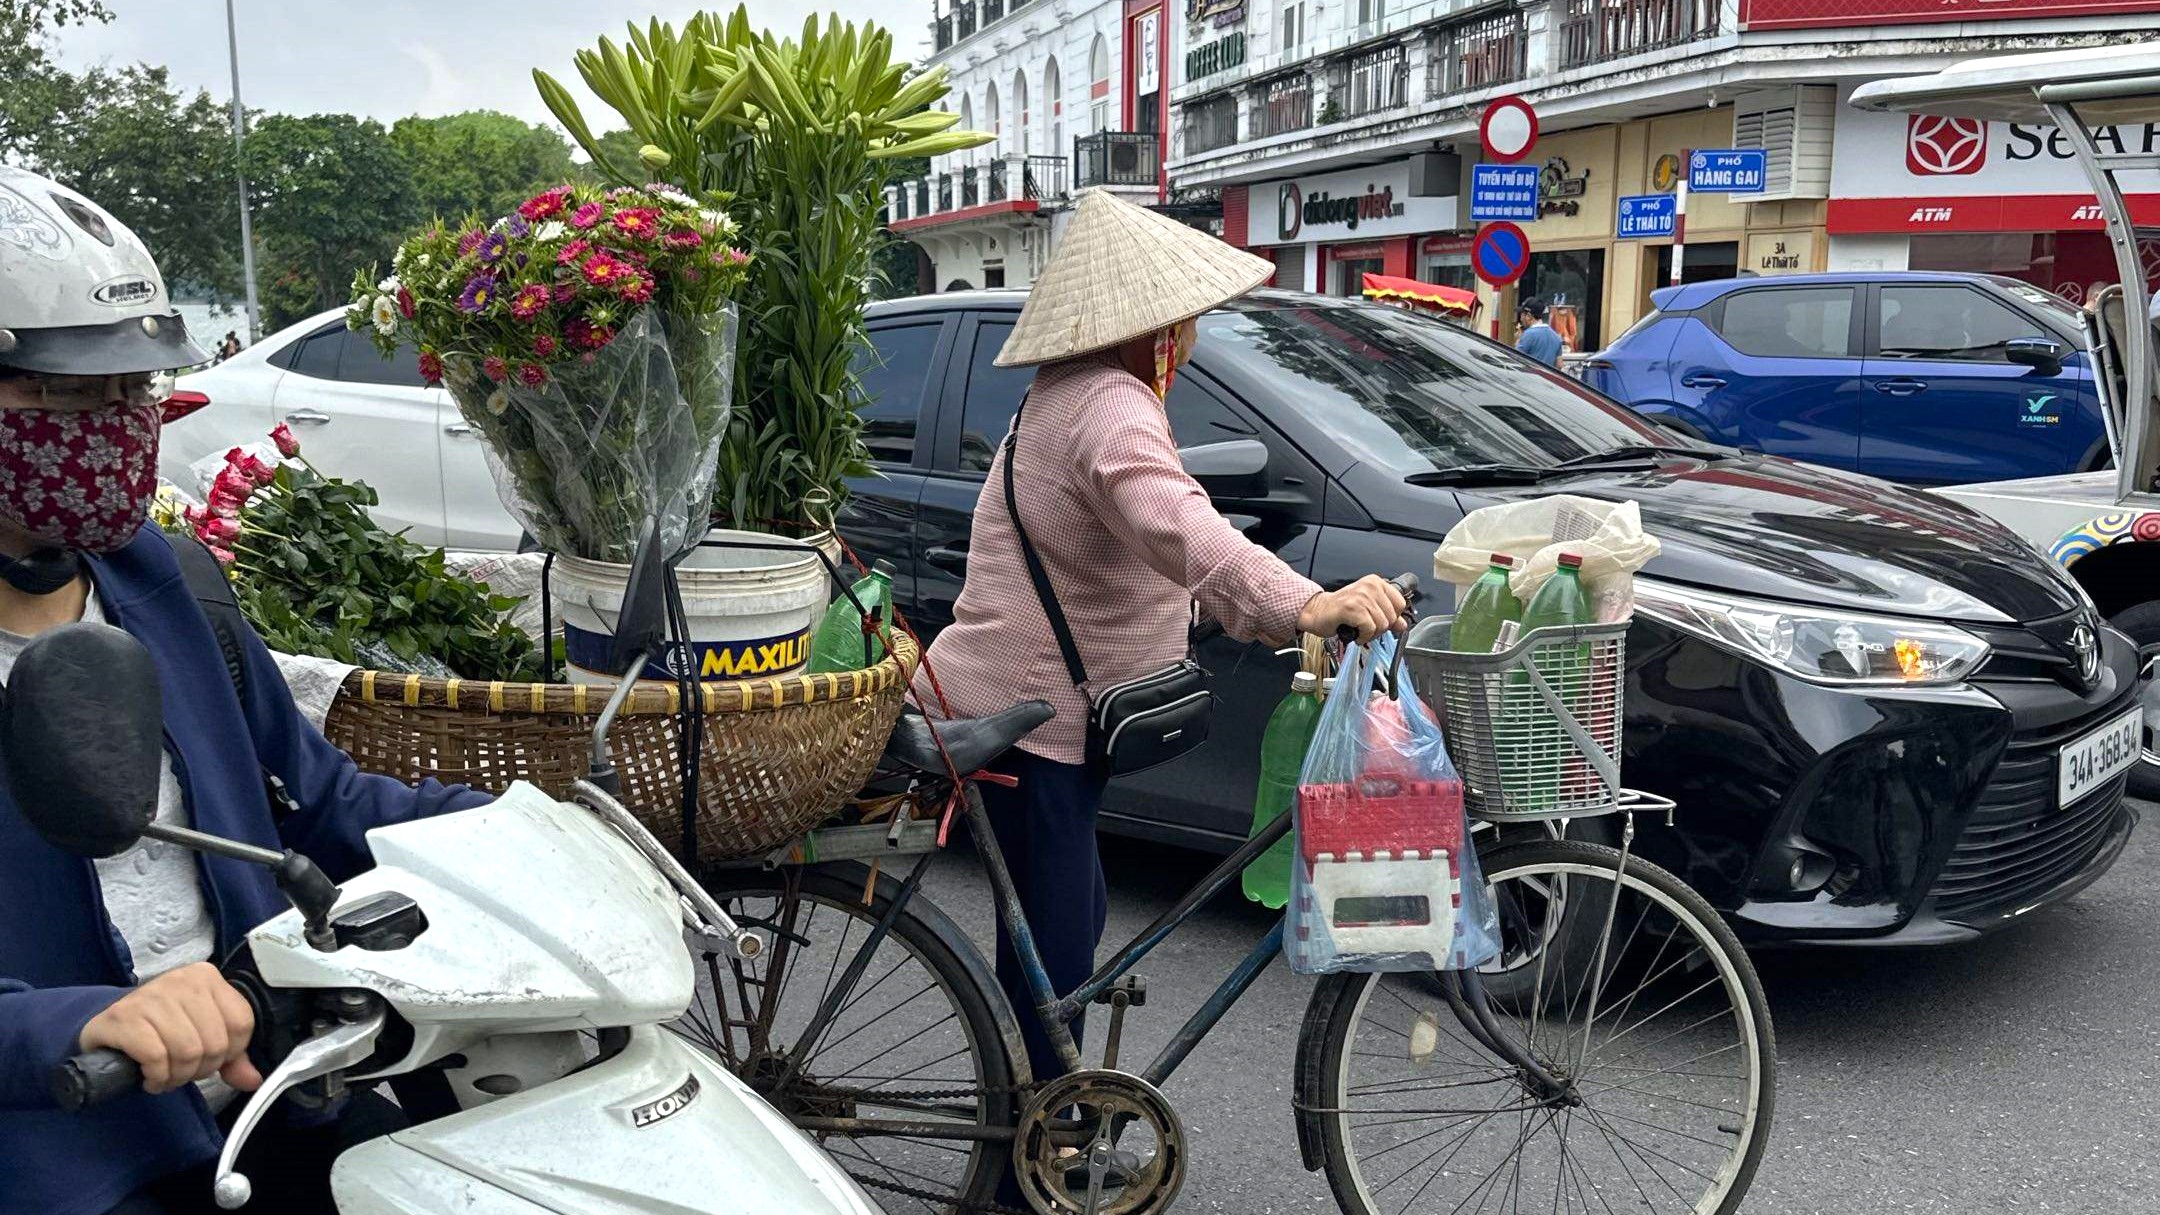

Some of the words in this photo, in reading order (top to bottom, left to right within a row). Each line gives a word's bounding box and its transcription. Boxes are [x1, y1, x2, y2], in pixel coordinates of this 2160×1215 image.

[1717, 154, 1743, 166] PHỐ
[1694, 167, 1732, 186] HÀNG
[1735, 170, 1759, 186] GAI
[1641, 200, 1661, 211] PHỐ
[1622, 214, 1634, 232] LÊ
[1635, 213, 1658, 231] THÁI
[1908, 207, 1953, 222] ATM
[1775, 242, 1786, 254] 3A
[700, 631, 811, 677] MAXILIT
[2069, 720, 2137, 790] 34A-368.94
